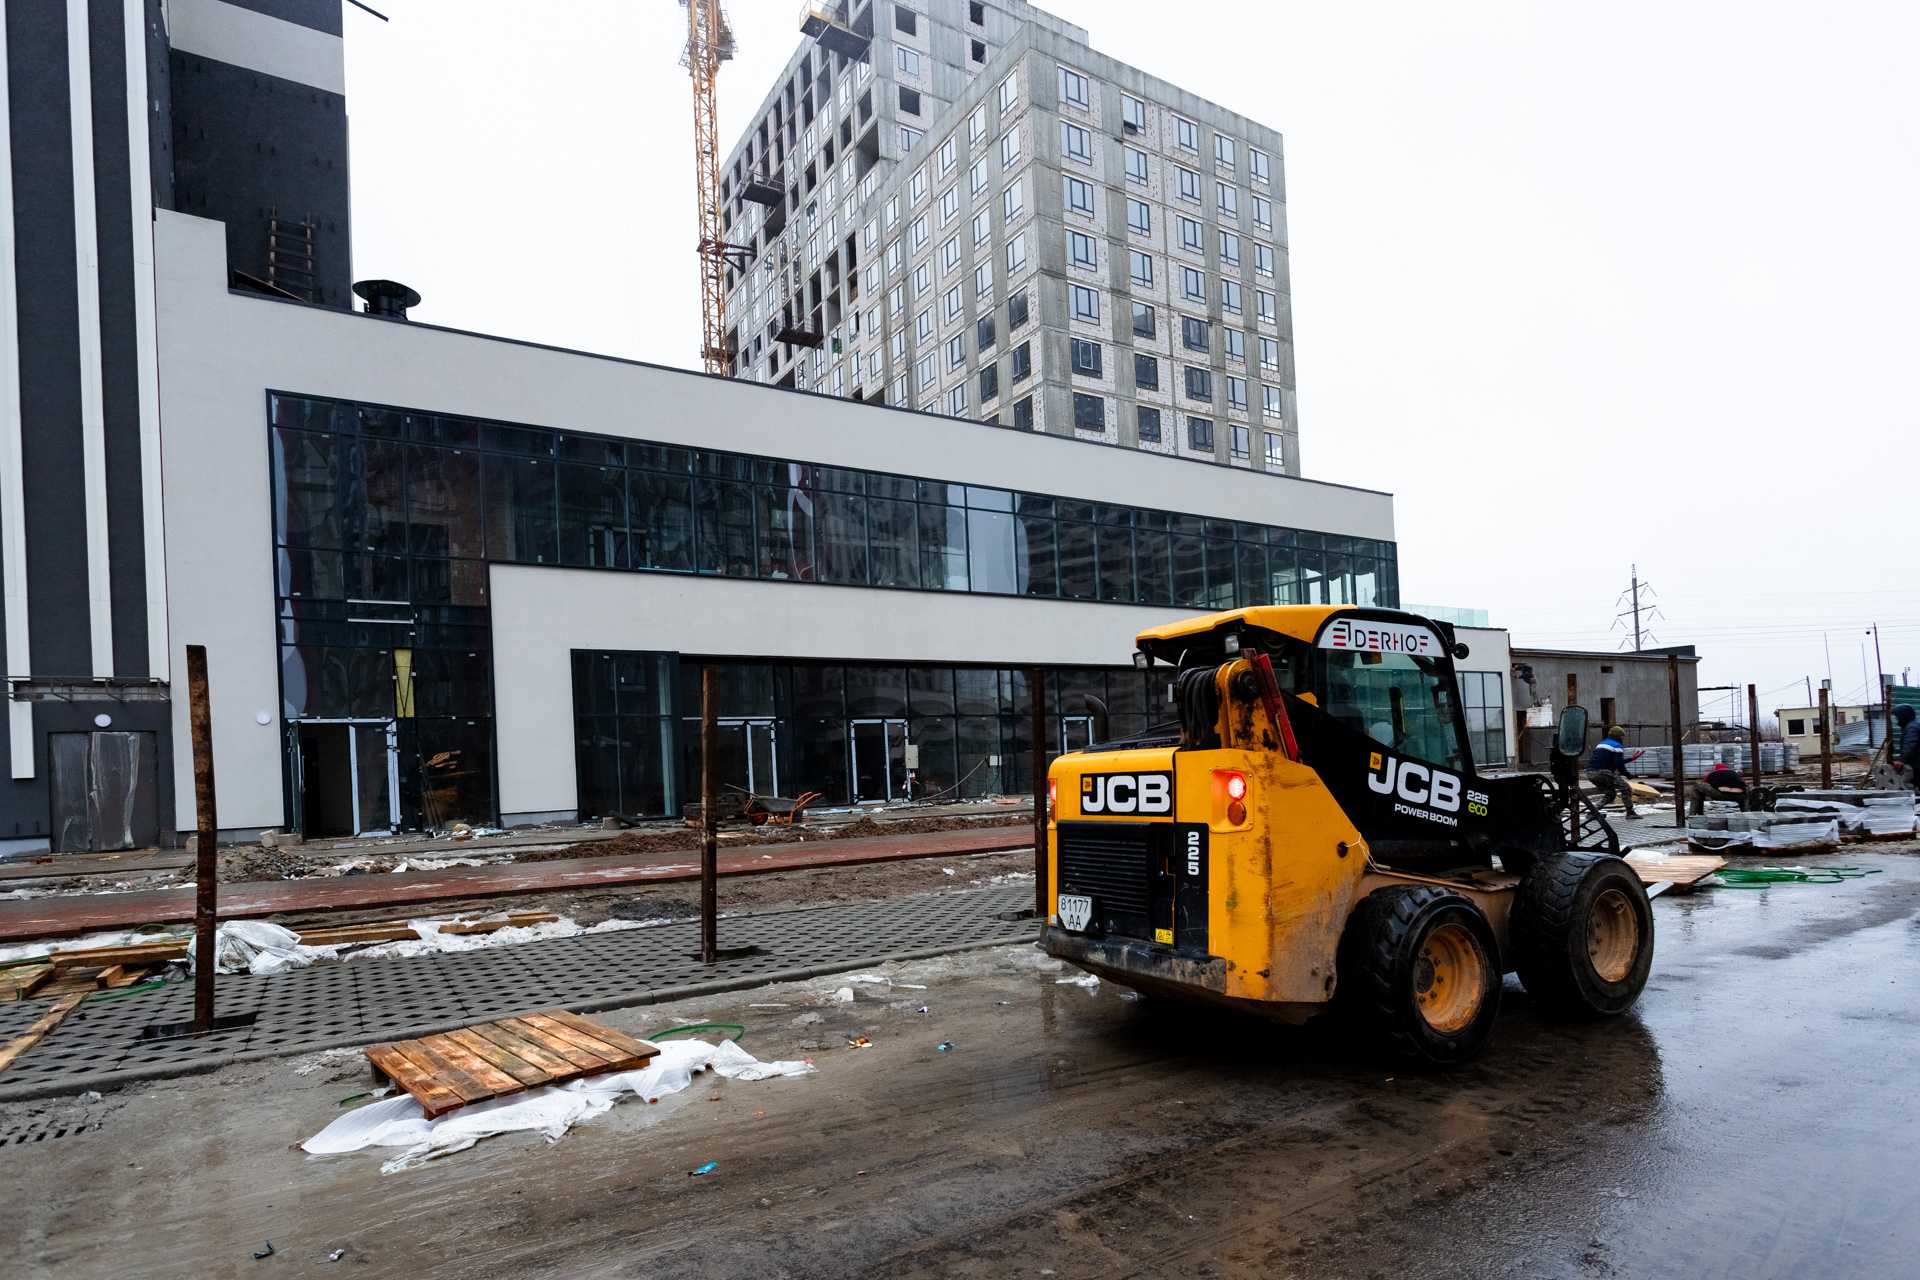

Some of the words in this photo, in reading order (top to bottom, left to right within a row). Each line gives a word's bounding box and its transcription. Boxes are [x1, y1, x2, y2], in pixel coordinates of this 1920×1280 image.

[1082, 775, 1170, 812] JCB
[1368, 756, 1461, 812] JCB
[1466, 790, 1489, 805] 225
[1468, 802, 1488, 817] eco
[1394, 803, 1429, 820] POWER
[1429, 812, 1458, 827] BOOM
[1187, 831, 1200, 876] 225
[1060, 898, 1089, 913] 81177
